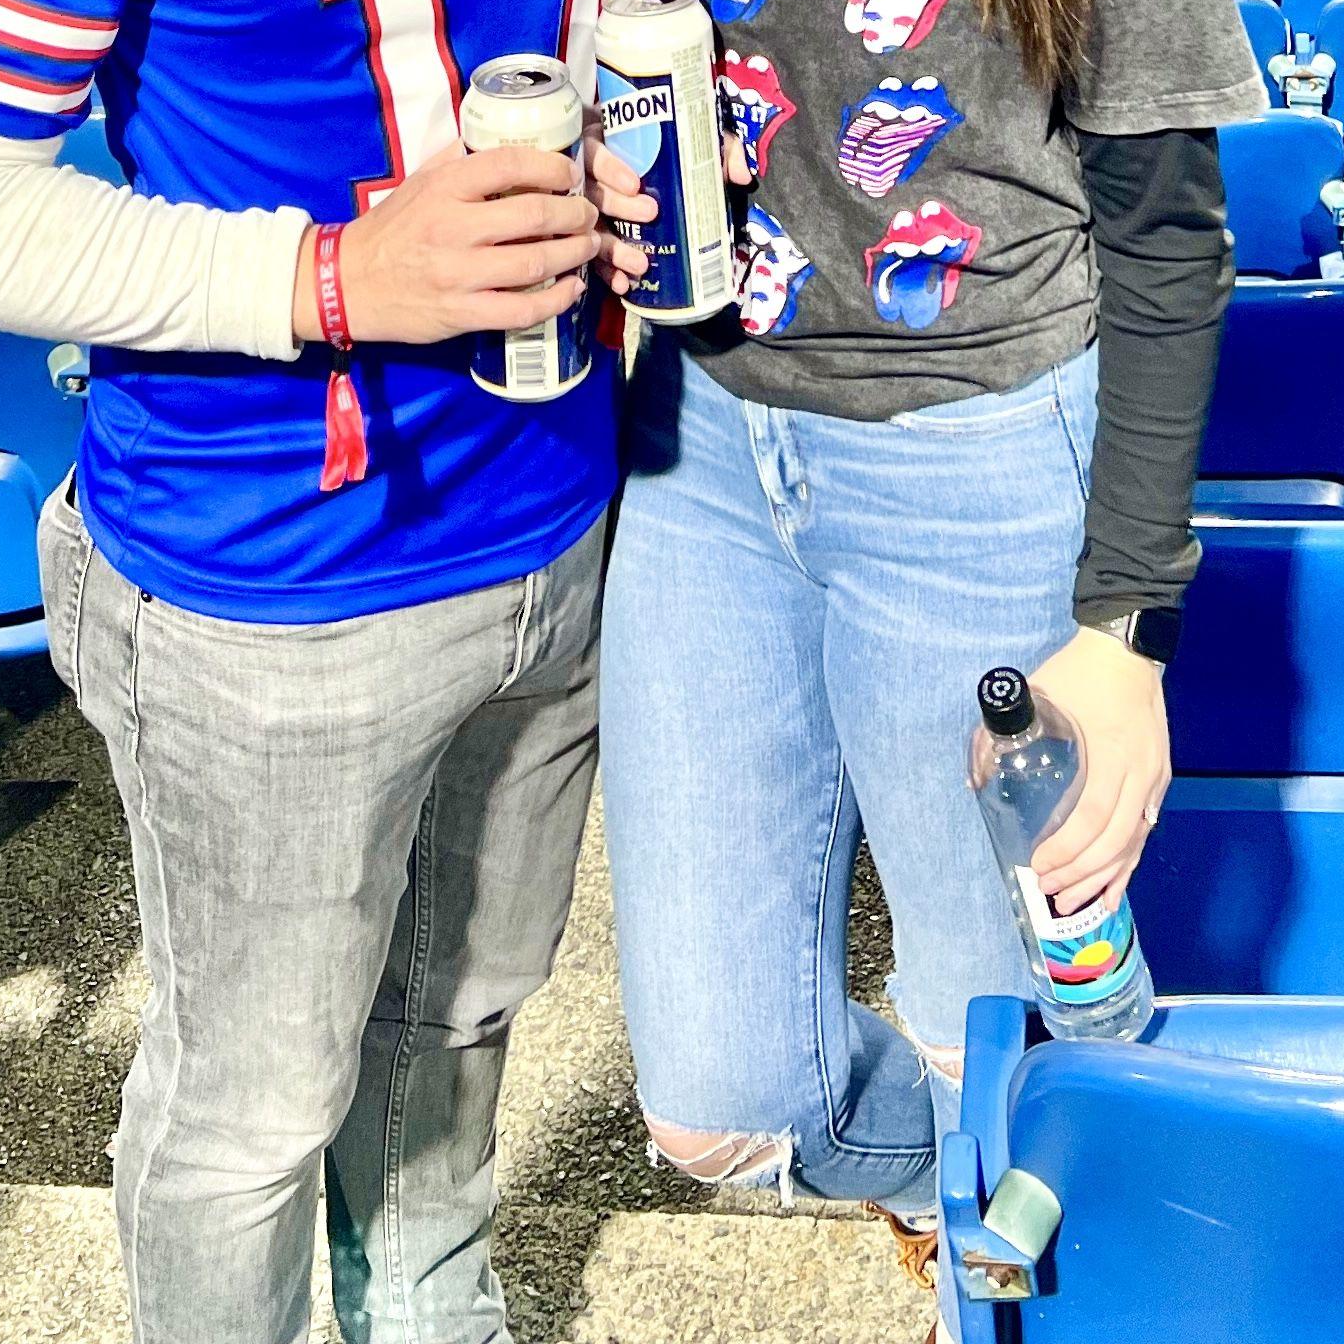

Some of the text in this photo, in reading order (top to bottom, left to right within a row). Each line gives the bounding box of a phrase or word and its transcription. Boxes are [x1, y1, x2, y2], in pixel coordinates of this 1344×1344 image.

[608, 92, 668, 129] MOON
[614, 220, 641, 241] ITE
[658, 244, 676, 255] ALE
